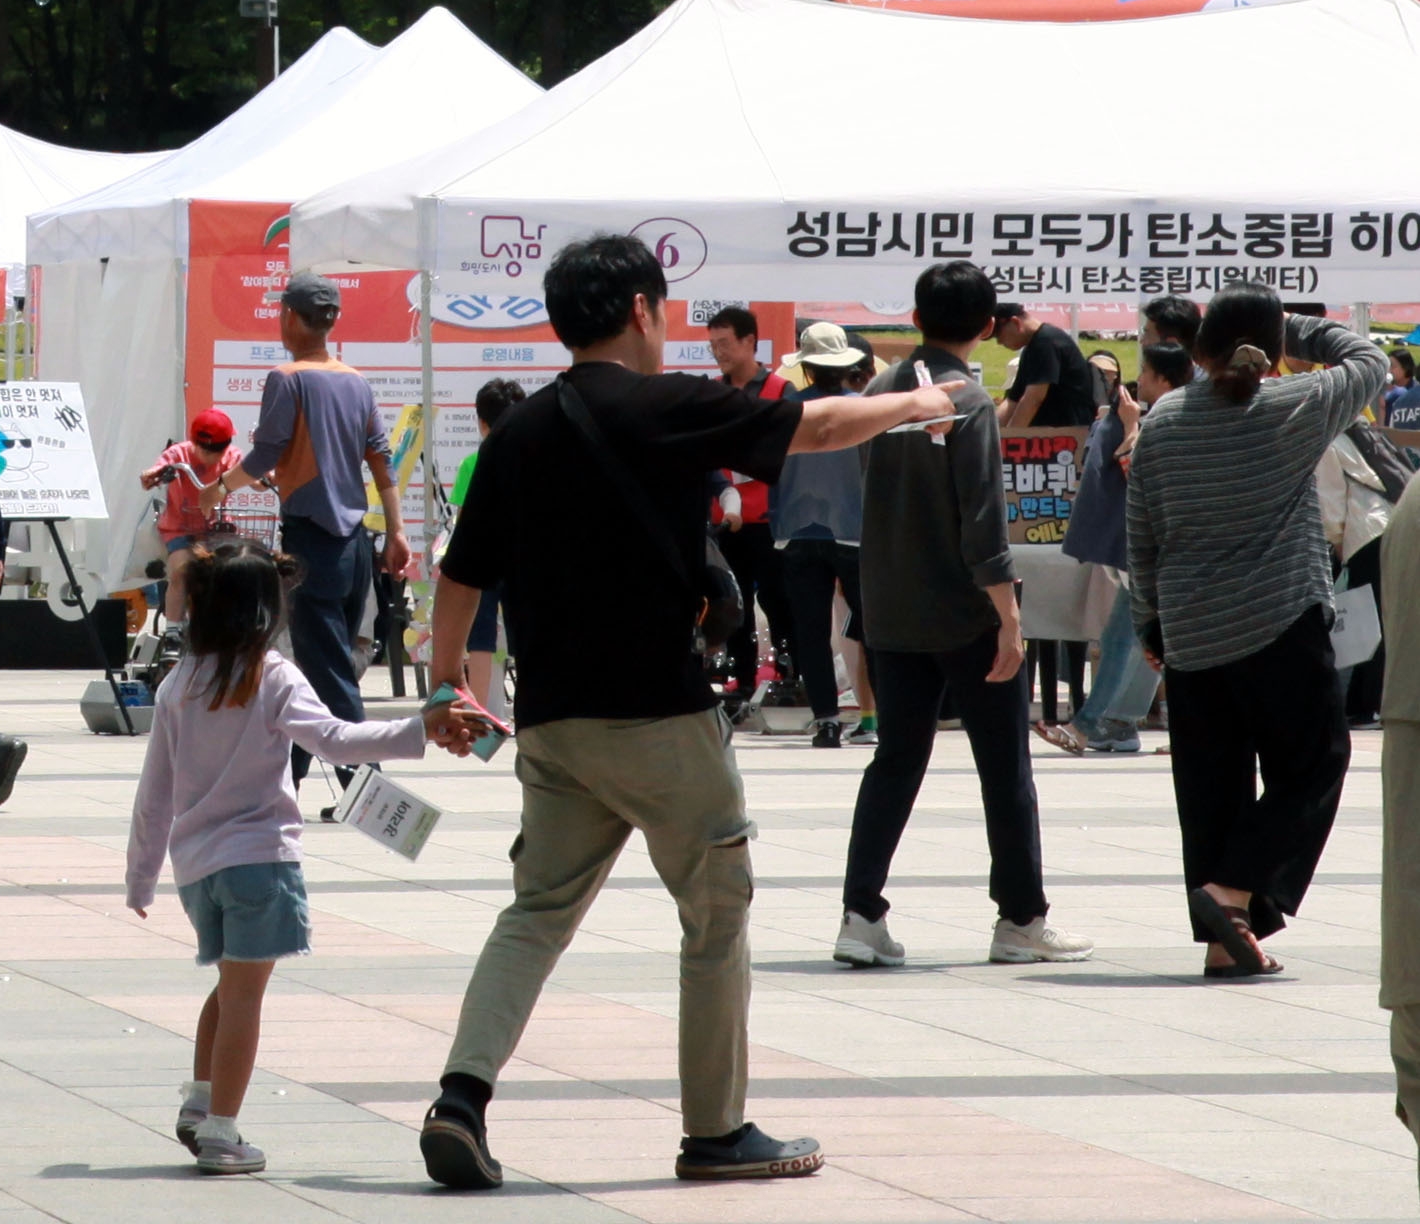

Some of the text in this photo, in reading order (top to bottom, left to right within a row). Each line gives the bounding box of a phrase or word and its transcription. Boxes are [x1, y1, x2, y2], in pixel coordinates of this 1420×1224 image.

[787, 211, 975, 258] 성남시민
[991, 213, 1134, 258] 모두가
[1147, 212, 1335, 258] 탄소중립
[655, 232, 680, 269] 6
[460, 262, 501, 275] 희망도시
[677, 345, 704, 360] 시간
[226, 378, 253, 392] 생생
